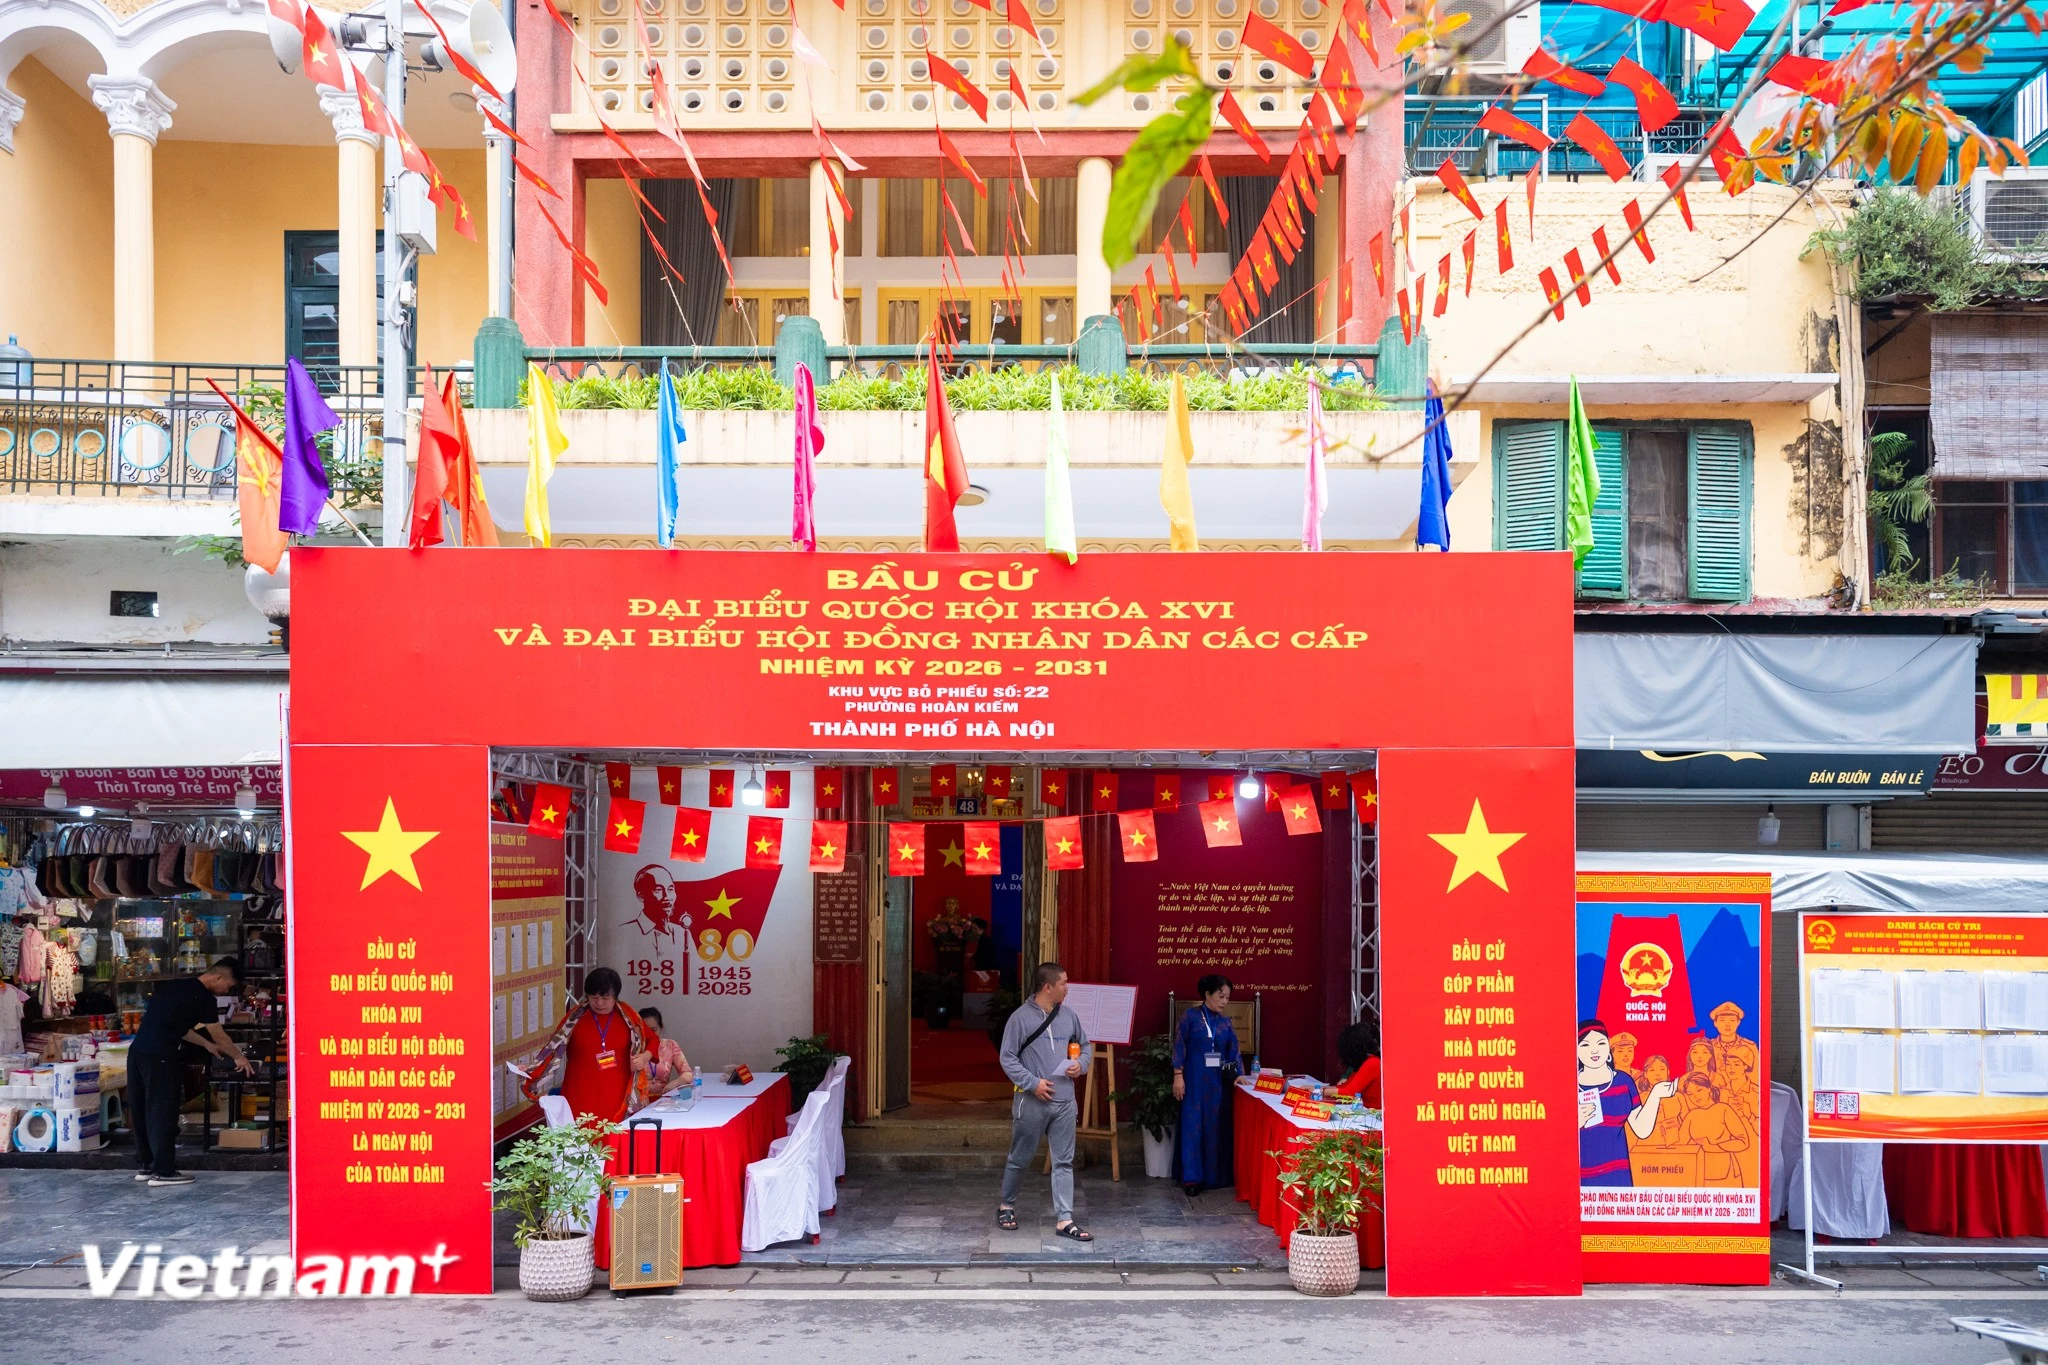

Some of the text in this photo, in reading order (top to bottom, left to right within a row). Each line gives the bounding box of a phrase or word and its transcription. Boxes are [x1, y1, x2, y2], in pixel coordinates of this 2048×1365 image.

[827, 561, 1039, 591] BẦU CỬ
[628, 589, 1234, 624] ĐẠI BIỂU QUỐC HỘI KHÓA XVI
[494, 618, 1368, 652] VÀ ĐẠI BIỂU HỘI ĐỒNG NHÂN DÂN CÁC CẤP
[760, 656, 864, 677] NHIỆM
[875, 657, 915, 675] KỲ
[926, 660, 1002, 675] 2026
[1035, 660, 1107, 675] 2031
[829, 686, 863, 697] KHU
[869, 686, 902, 699] VỰC
[908, 684, 931, 698] BỎ
[937, 684, 987, 698] PHIẾU
[845, 699, 1018, 713] PHƯỜNG HOÀN KIẾM
[809, 718, 1054, 739] THÀNH PHỐ HÀ NỘI
[1809, 769, 1924, 784] BÁN BUÔN BÁN LẺ
[1941, 777, 1970, 785] Boutique
[94, 779, 230, 797] Thời Trang Trẻ Em
[960, 801, 974, 813] 48
[1887, 921, 1981, 931] DANH SÁCH CỬ TRI
[367, 936, 416, 960] BẦU CỬ
[698, 929, 755, 962] 80
[1452, 938, 1506, 961] BẦU CỬ
[627, 960, 674, 977] 19-8
[698, 966, 751, 980] 1945
[330, 967, 453, 995] ĐẠI BIỂU QUỐC HỘI
[638, 978, 674, 995] 2-9
[698, 979, 751, 995] 2025
[1443, 969, 1514, 993] GÓP PHẦN
[362, 1003, 422, 1023] KHÓA XVI
[1444, 1005, 1514, 1028] XÂY DỰNG
[1626, 1000, 1666, 1012] QUỐC HỘI
[1626, 1013, 1666, 1021] KHOÁ XVI
[320, 1031, 464, 1059] VÀ ĐẠI BIỂU HỘI ĐỒNG
[1444, 1036, 1516, 1057] NHÀ NƯỚC
[330, 1064, 456, 1087] NHÂN DÂN CÁC CẤP
[1437, 1065, 1524, 1089] PHÁP QUYỀN
[320, 1099, 363, 1122] NHIỆM
[367, 1099, 384, 1119] KỲ
[387, 1102, 420, 1119] 2026
[435, 1102, 465, 1119] 2031
[1417, 1099, 1546, 1124] XÃ HỘI CHỦ NGHĨA
[353, 1131, 432, 1154] LÀ NGÀY HỘI
[1448, 1132, 1516, 1156] VIỆT NAM
[346, 1161, 444, 1183] CỦA TOÀN DÂN!
[1437, 1164, 1528, 1187] VỮNG MẠNH!
[1598, 1191, 1618, 1202] MỪNG
[1620, 1192, 1637, 1203] NGÀY
[1639, 1191, 1652, 1203] BẦU
[1654, 1192, 1664, 1203] CỬ
[1664, 1193, 1676, 1204] ĐẠI
[1677, 1191, 1692, 1203] BIỂU
[1694, 1191, 1711, 1204] QUỐC
[1713, 1192, 1724, 1205] HỘI
[1725, 1193, 1743, 1204] KHÓA
[1745, 1194, 1755, 1204] XVI
[1584, 1203, 1755, 1217] HỘI ĐỒNG NHÂN DÂN CÁC CẤP NHIỆM KỲ 2026 2031!
